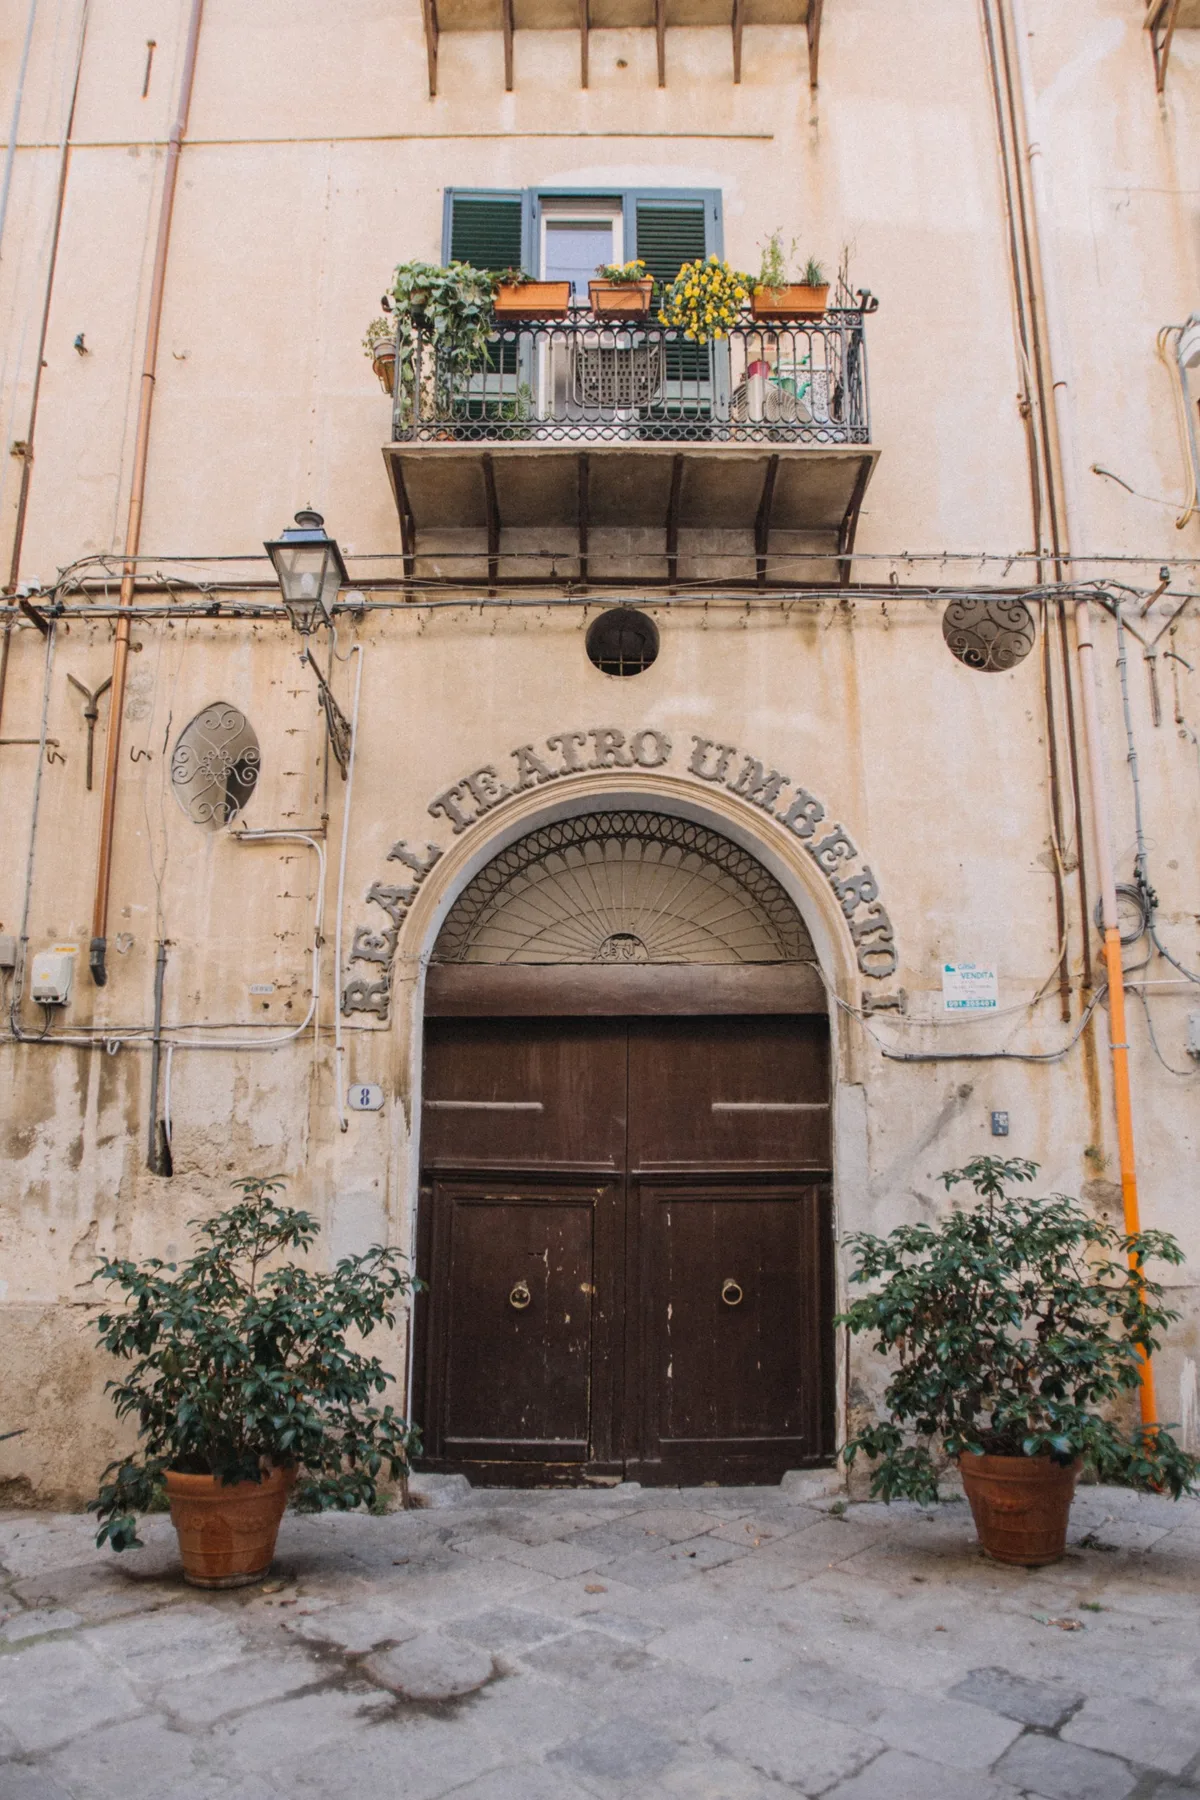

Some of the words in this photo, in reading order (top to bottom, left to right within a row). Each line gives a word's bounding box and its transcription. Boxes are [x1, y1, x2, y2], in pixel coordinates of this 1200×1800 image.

[339, 839, 444, 1021] REAL
[427, 728, 673, 835] TEATRO
[686, 734, 899, 979] UMBERTO
[961, 971, 994, 979] VENDITA
[360, 1087, 370, 1106] 8
